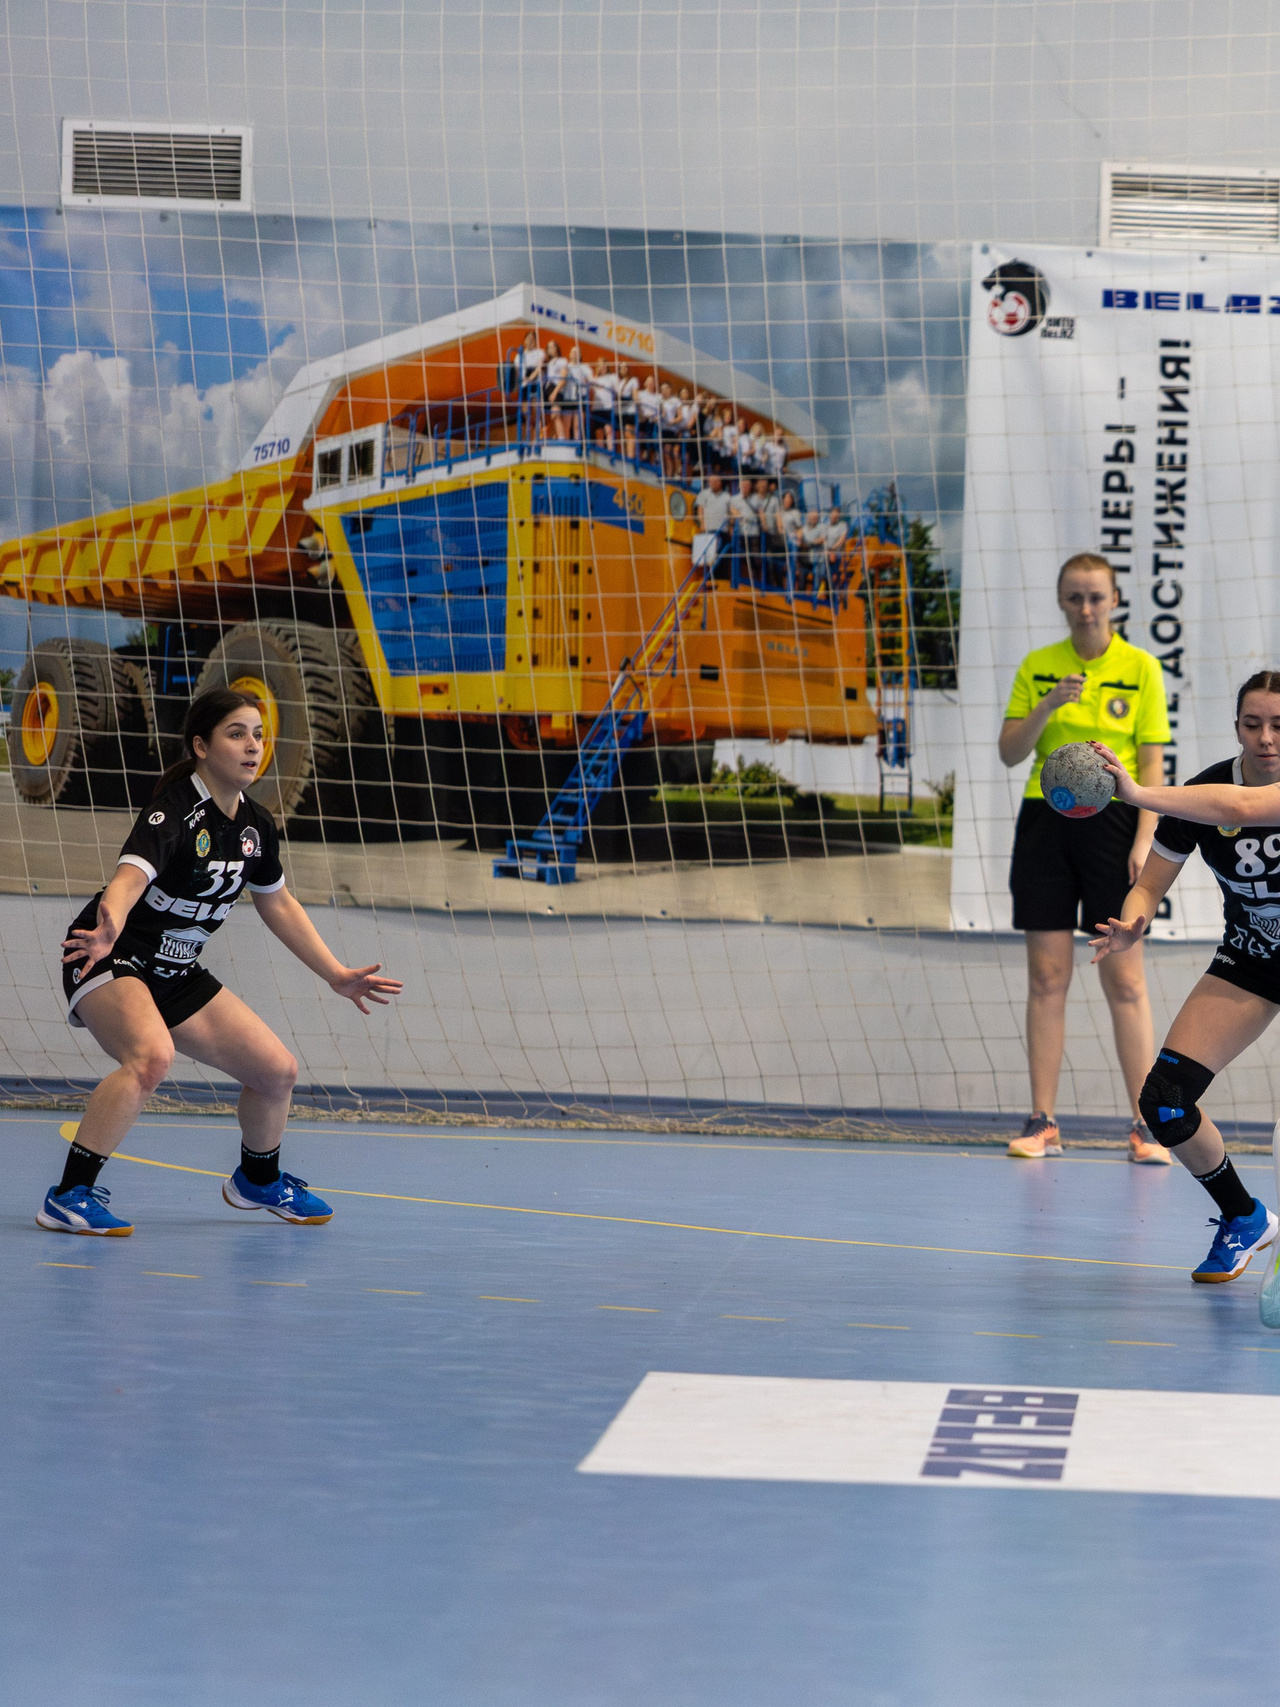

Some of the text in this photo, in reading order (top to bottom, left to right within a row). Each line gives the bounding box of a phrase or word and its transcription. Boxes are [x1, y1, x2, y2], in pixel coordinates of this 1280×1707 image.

[253, 437, 291, 463] 75710
[1149, 339, 1192, 678] ДОСТИЖЕНИЯ!
[196, 860, 245, 899] 33
[144, 884, 239, 922] BELA
[920, 1388, 1079, 1482] BELAZ
